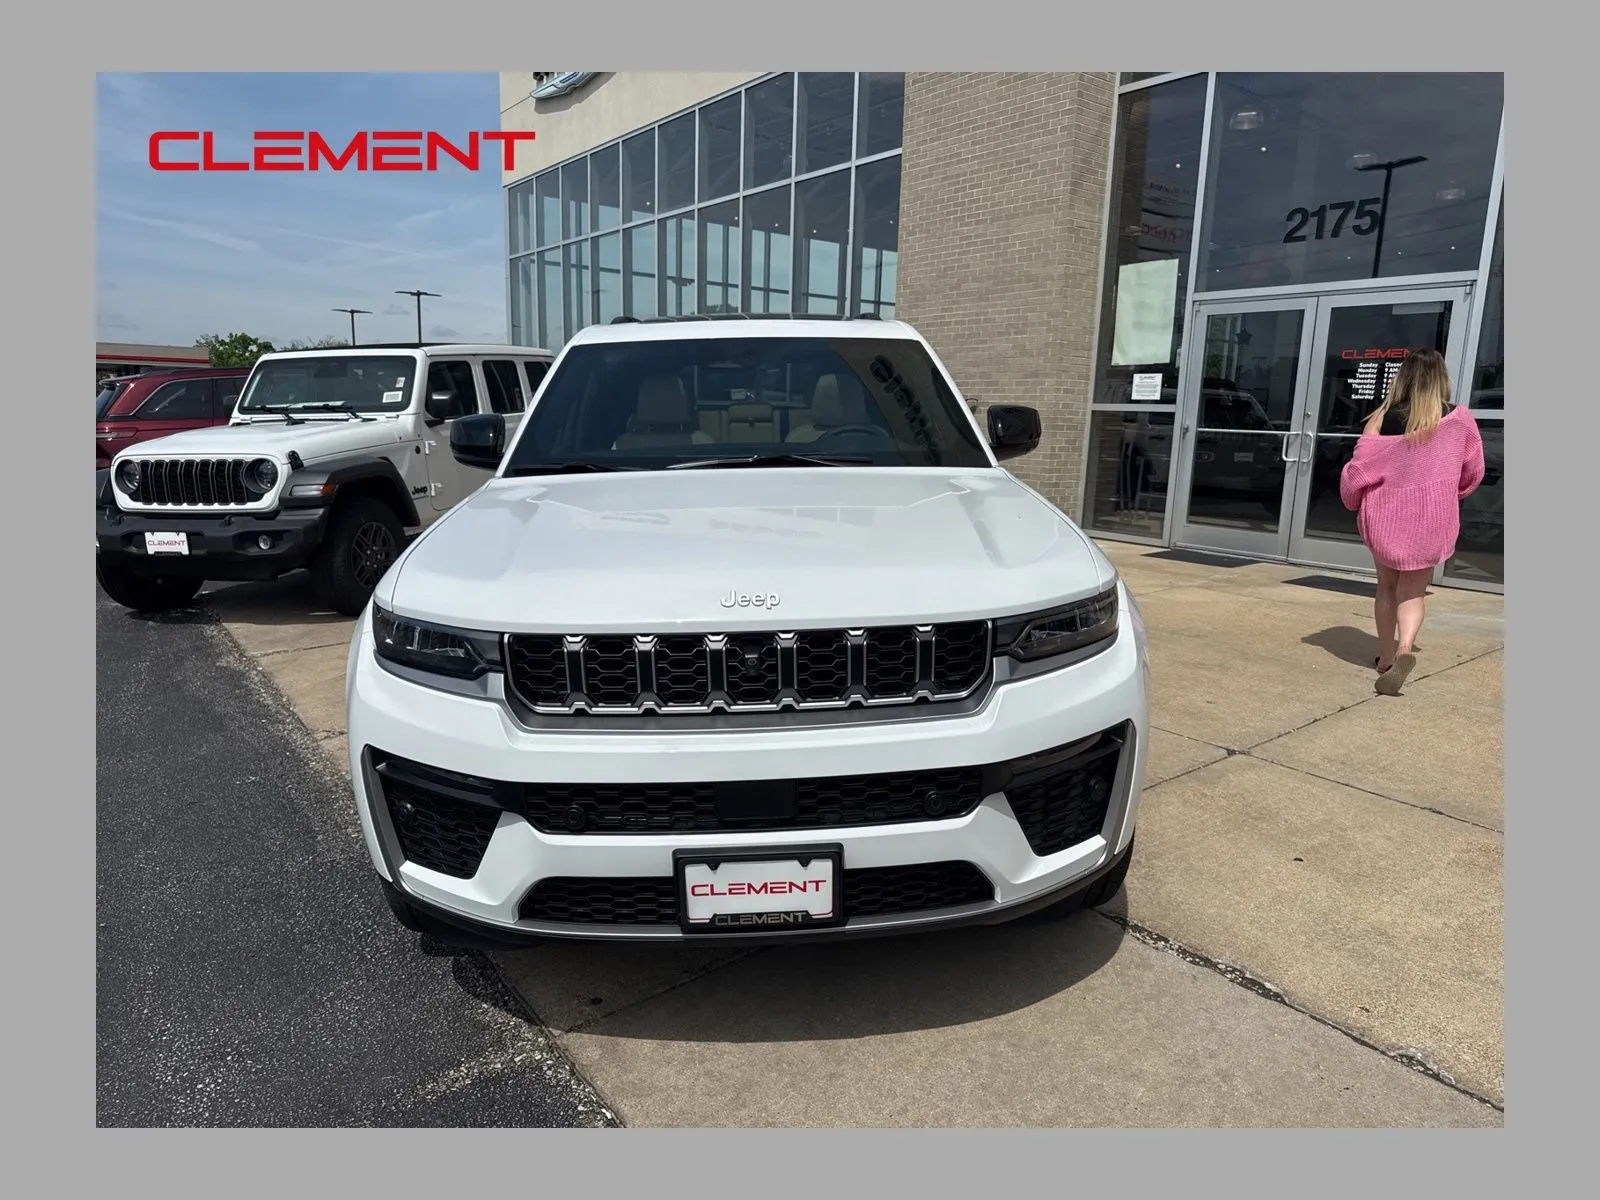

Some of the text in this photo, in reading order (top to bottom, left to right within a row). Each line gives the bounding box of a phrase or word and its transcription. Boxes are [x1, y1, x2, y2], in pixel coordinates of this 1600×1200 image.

[1283, 197, 1381, 244] 2175
[412, 486, 428, 495] Jeep
[720, 590, 780, 610] Jeep
[691, 880, 827, 897] CLEMENT
[715, 912, 807, 926] CLEMENT
